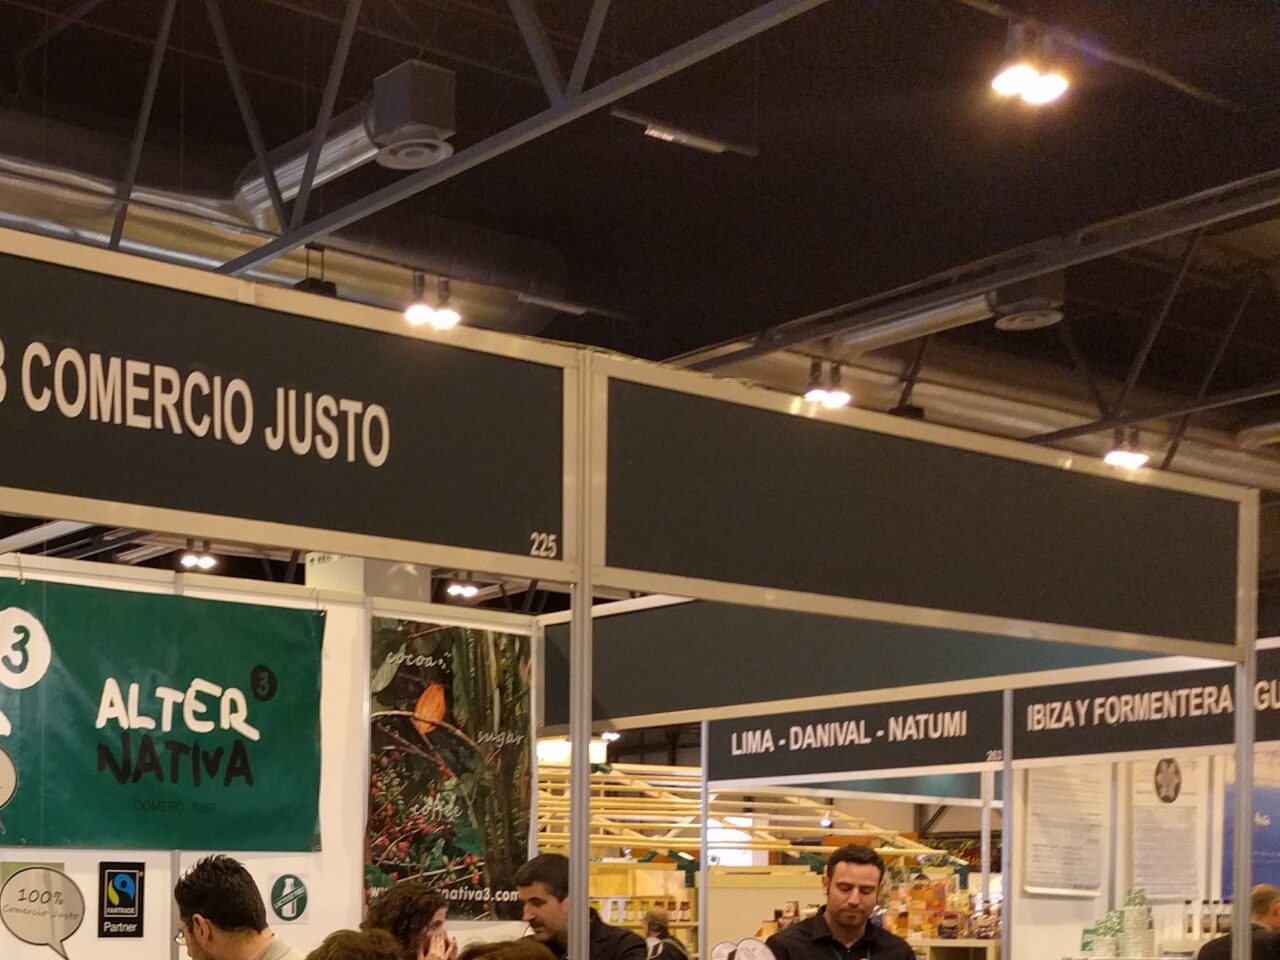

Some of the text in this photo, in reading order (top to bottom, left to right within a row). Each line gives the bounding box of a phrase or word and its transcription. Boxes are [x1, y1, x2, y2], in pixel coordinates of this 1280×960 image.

[22, 341, 254, 446] COMERCIO
[263, 391, 392, 469] JUSTO
[529, 530, 558, 558] 225
[95, 677, 261, 741] ALTER
[1026, 684, 1234, 731] IBIZA Y FORMENTERA
[730, 710, 968, 756] LIMA DANIVAL NATUMI
[96, 731, 255, 788] NATIVA
[17, 888, 64, 906] 100%
[103, 920, 138, 933] Partner
